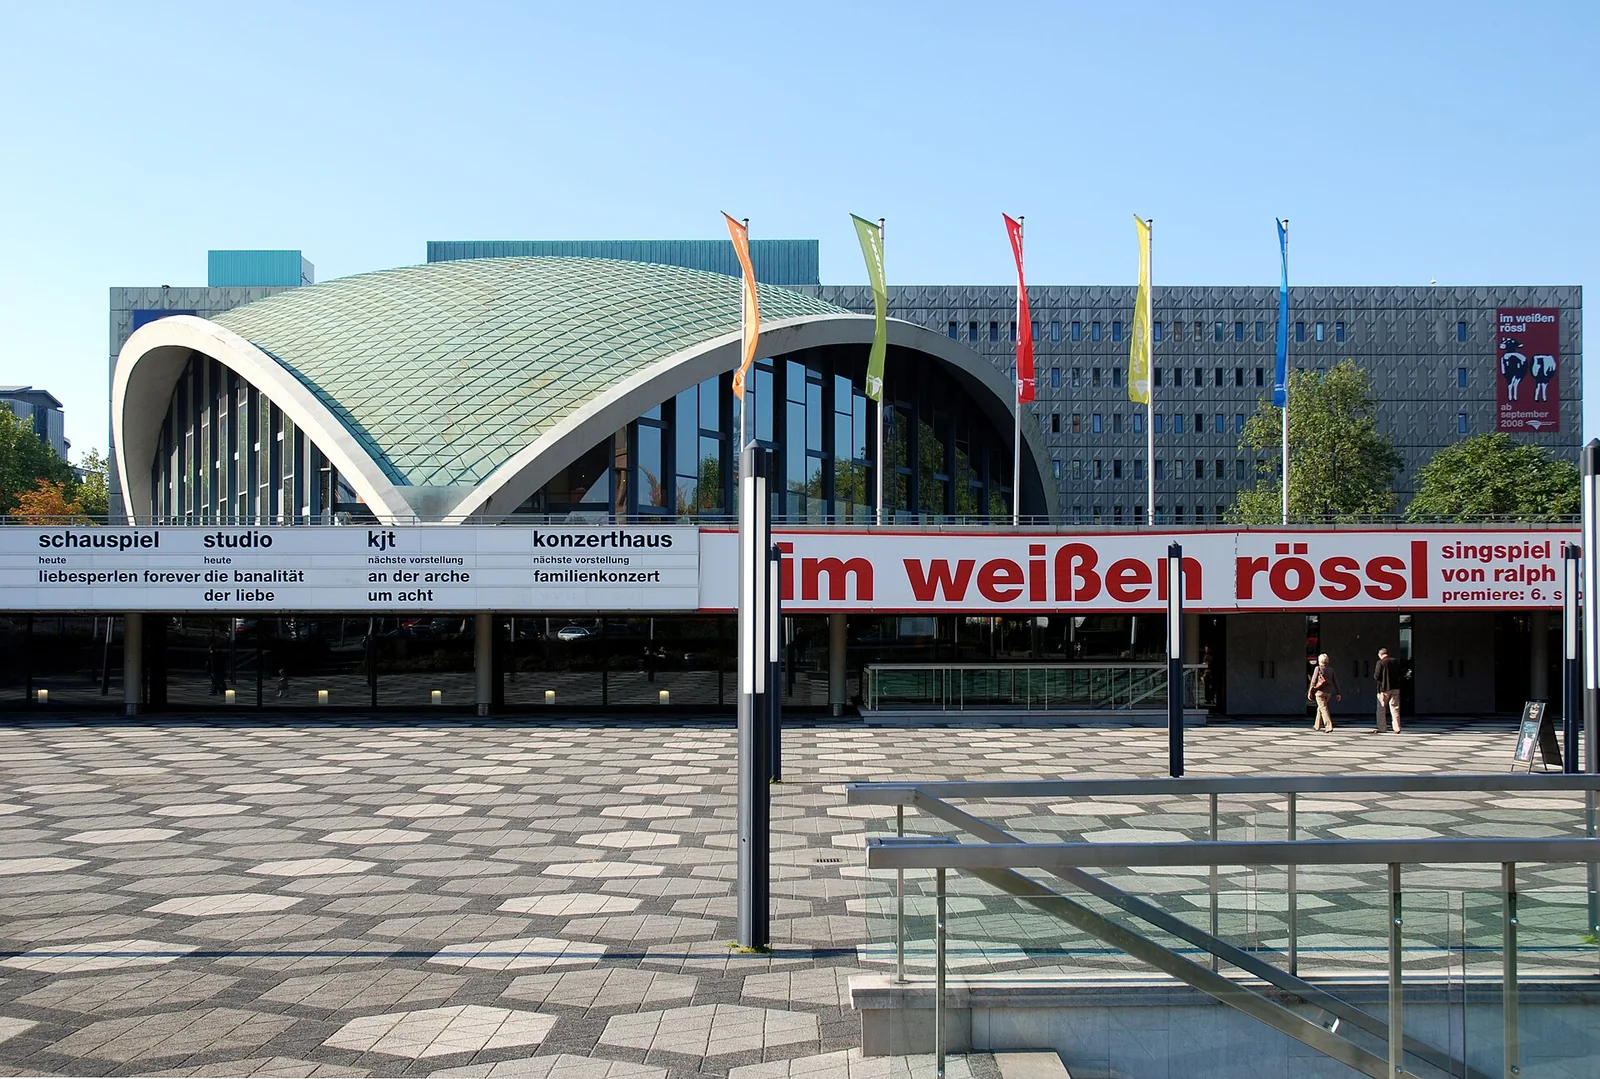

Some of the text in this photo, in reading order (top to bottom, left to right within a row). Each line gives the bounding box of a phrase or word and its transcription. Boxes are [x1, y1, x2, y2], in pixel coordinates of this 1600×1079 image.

[1499, 313, 1555, 323] im weißen
[1499, 323, 1526, 332] rössl
[1501, 403, 1512, 411] ab
[1500, 410, 1549, 419] september
[1501, 419, 1524, 428] 2008
[38, 530, 160, 551] schauspiel
[203, 530, 273, 549] studio
[367, 530, 396, 551] kjt
[533, 530, 673, 548] konzerthaus
[1441, 541, 1551, 563] singspiel
[38, 555, 67, 565] heute
[203, 555, 232, 565] heute
[368, 555, 464, 566] nächste vorstellung
[533, 555, 630, 566] nächste vorstellung
[38, 569, 201, 585] liebesperlen forever
[204, 569, 305, 584] die banalität
[368, 569, 470, 583] an der arche
[533, 569, 661, 583] familienkonzert
[777, 541, 1429, 602] im weißen rössl
[1441, 568, 1485, 583] von
[1494, 563, 1556, 586] ralph
[203, 588, 276, 602] der liebe
[368, 588, 434, 603] um acht
[1441, 588, 1524, 603] premiere:
[1530, 588, 1547, 601] 6.
